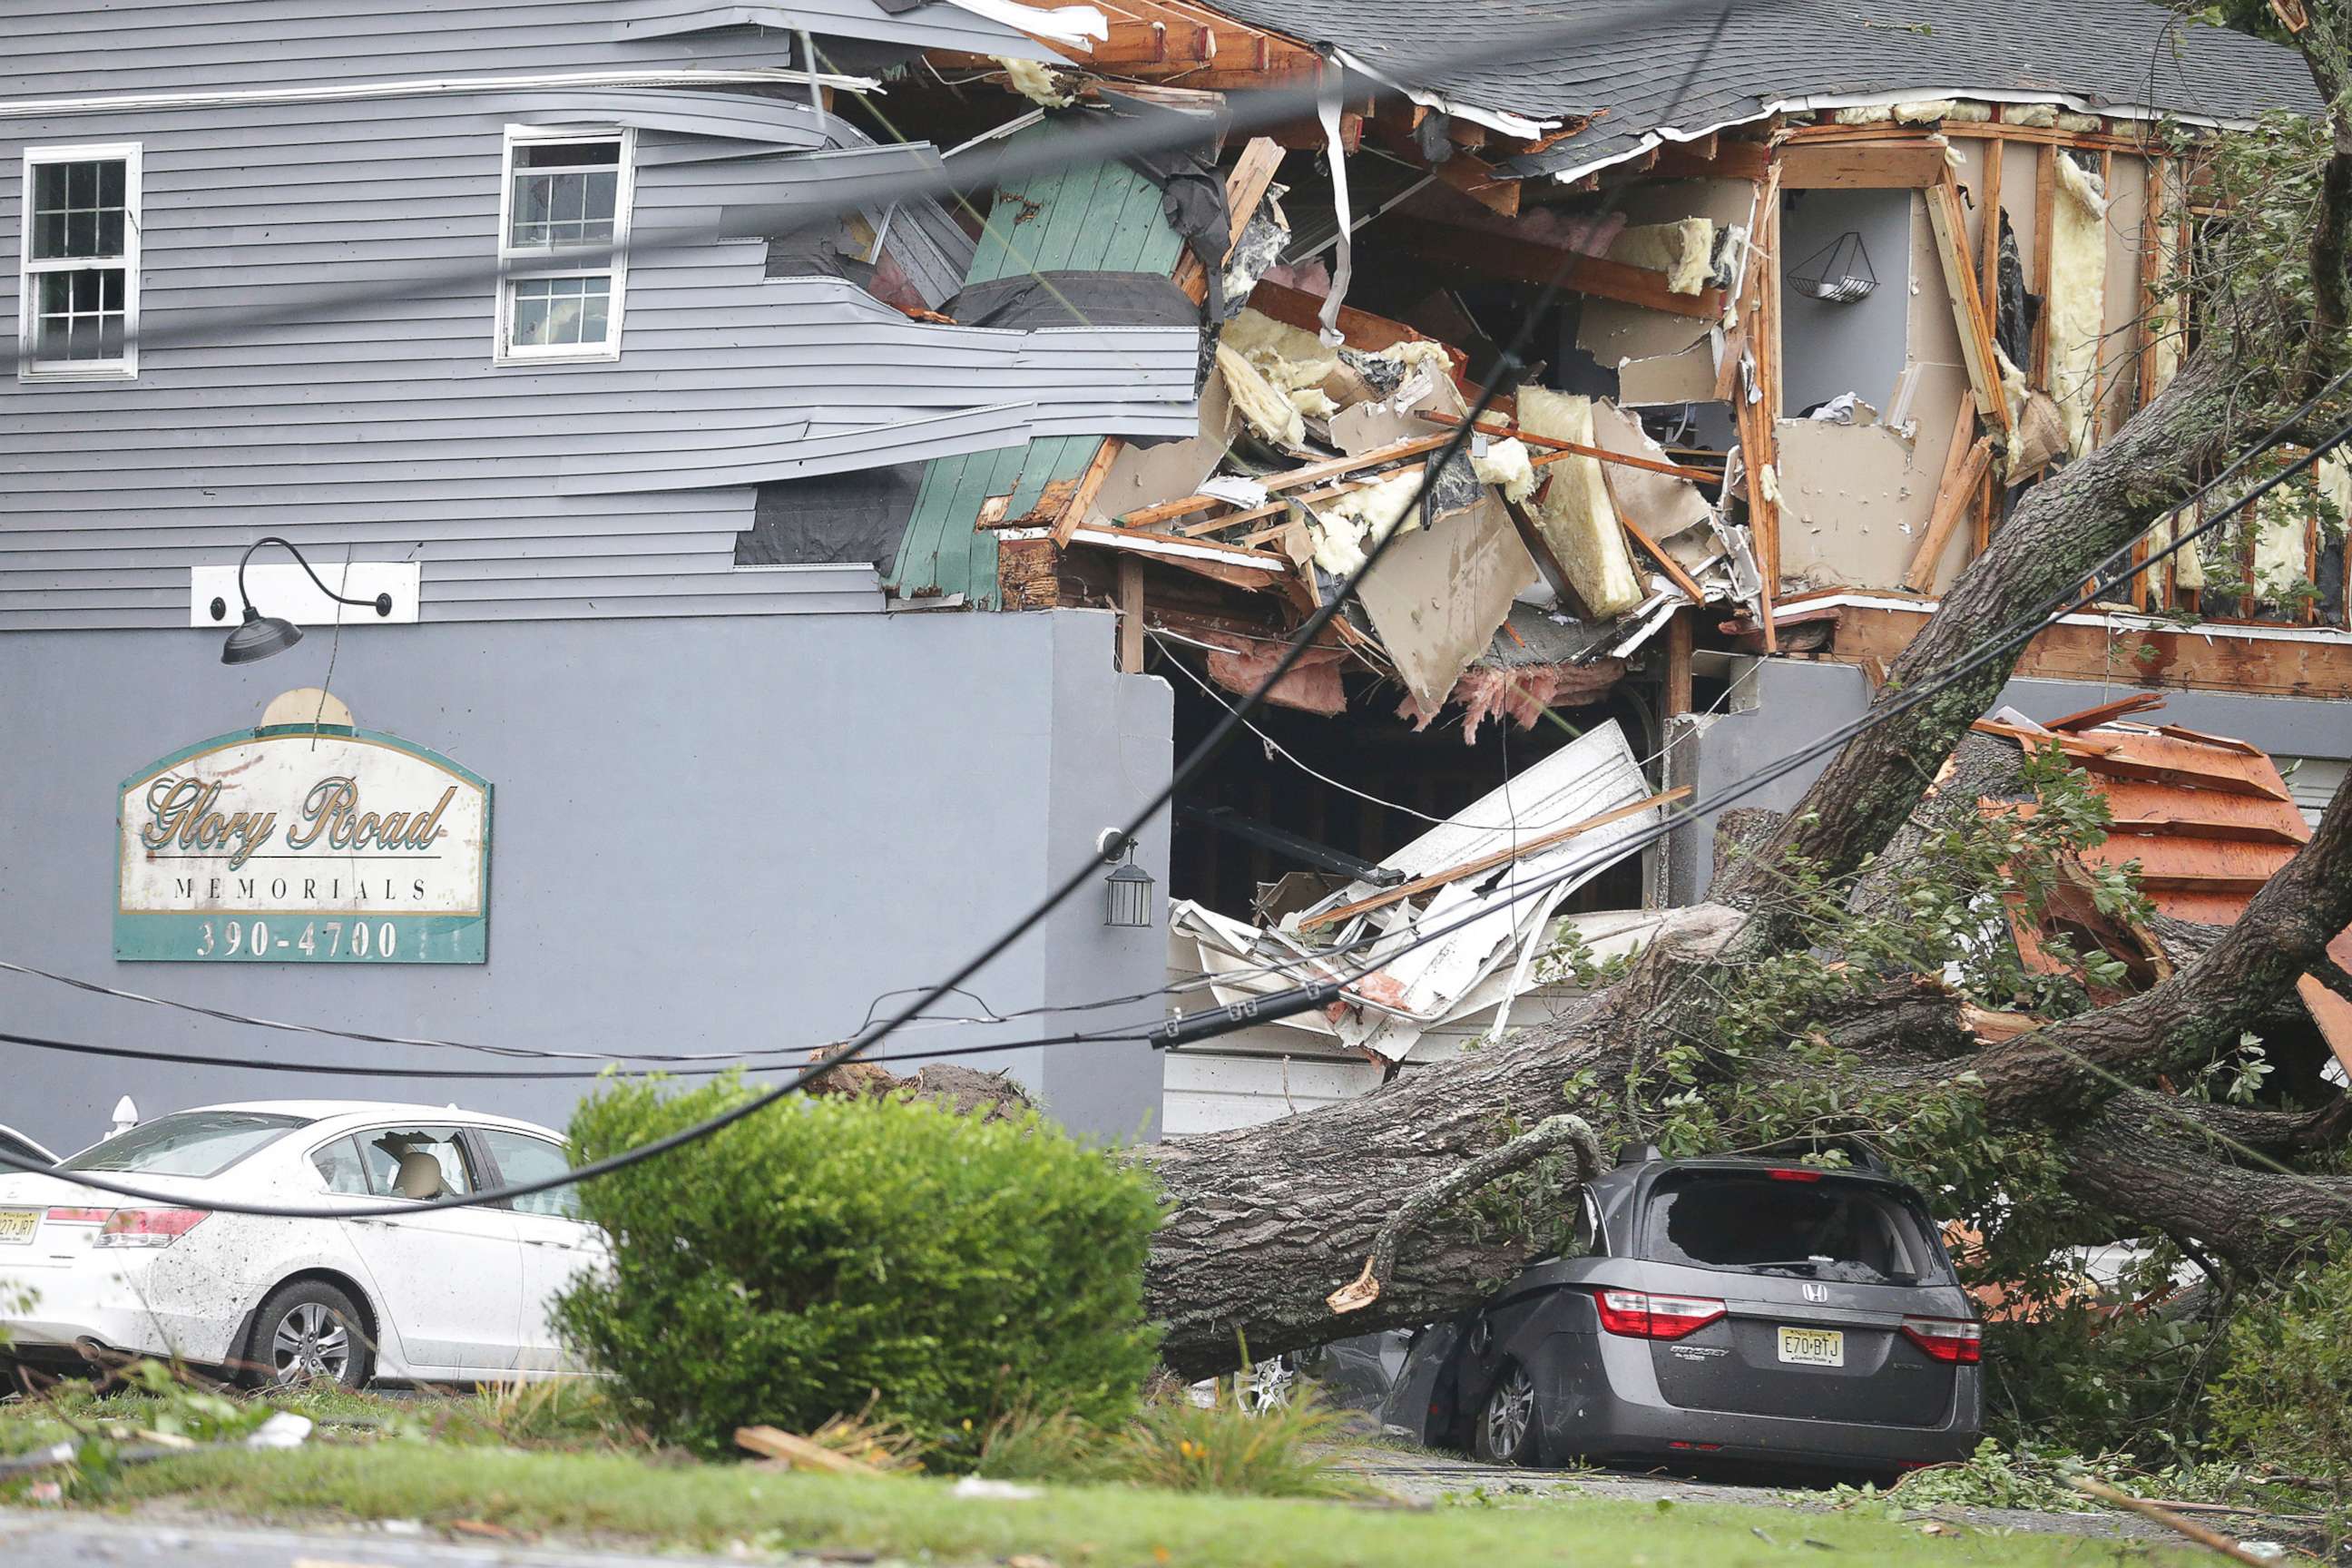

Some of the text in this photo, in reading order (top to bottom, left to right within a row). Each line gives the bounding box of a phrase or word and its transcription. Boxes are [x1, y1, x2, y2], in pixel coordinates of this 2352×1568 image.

[142, 776, 457, 871] Glory Road
[174, 877, 426, 900] MEMORIALS
[196, 920, 397, 958] 390-4700
